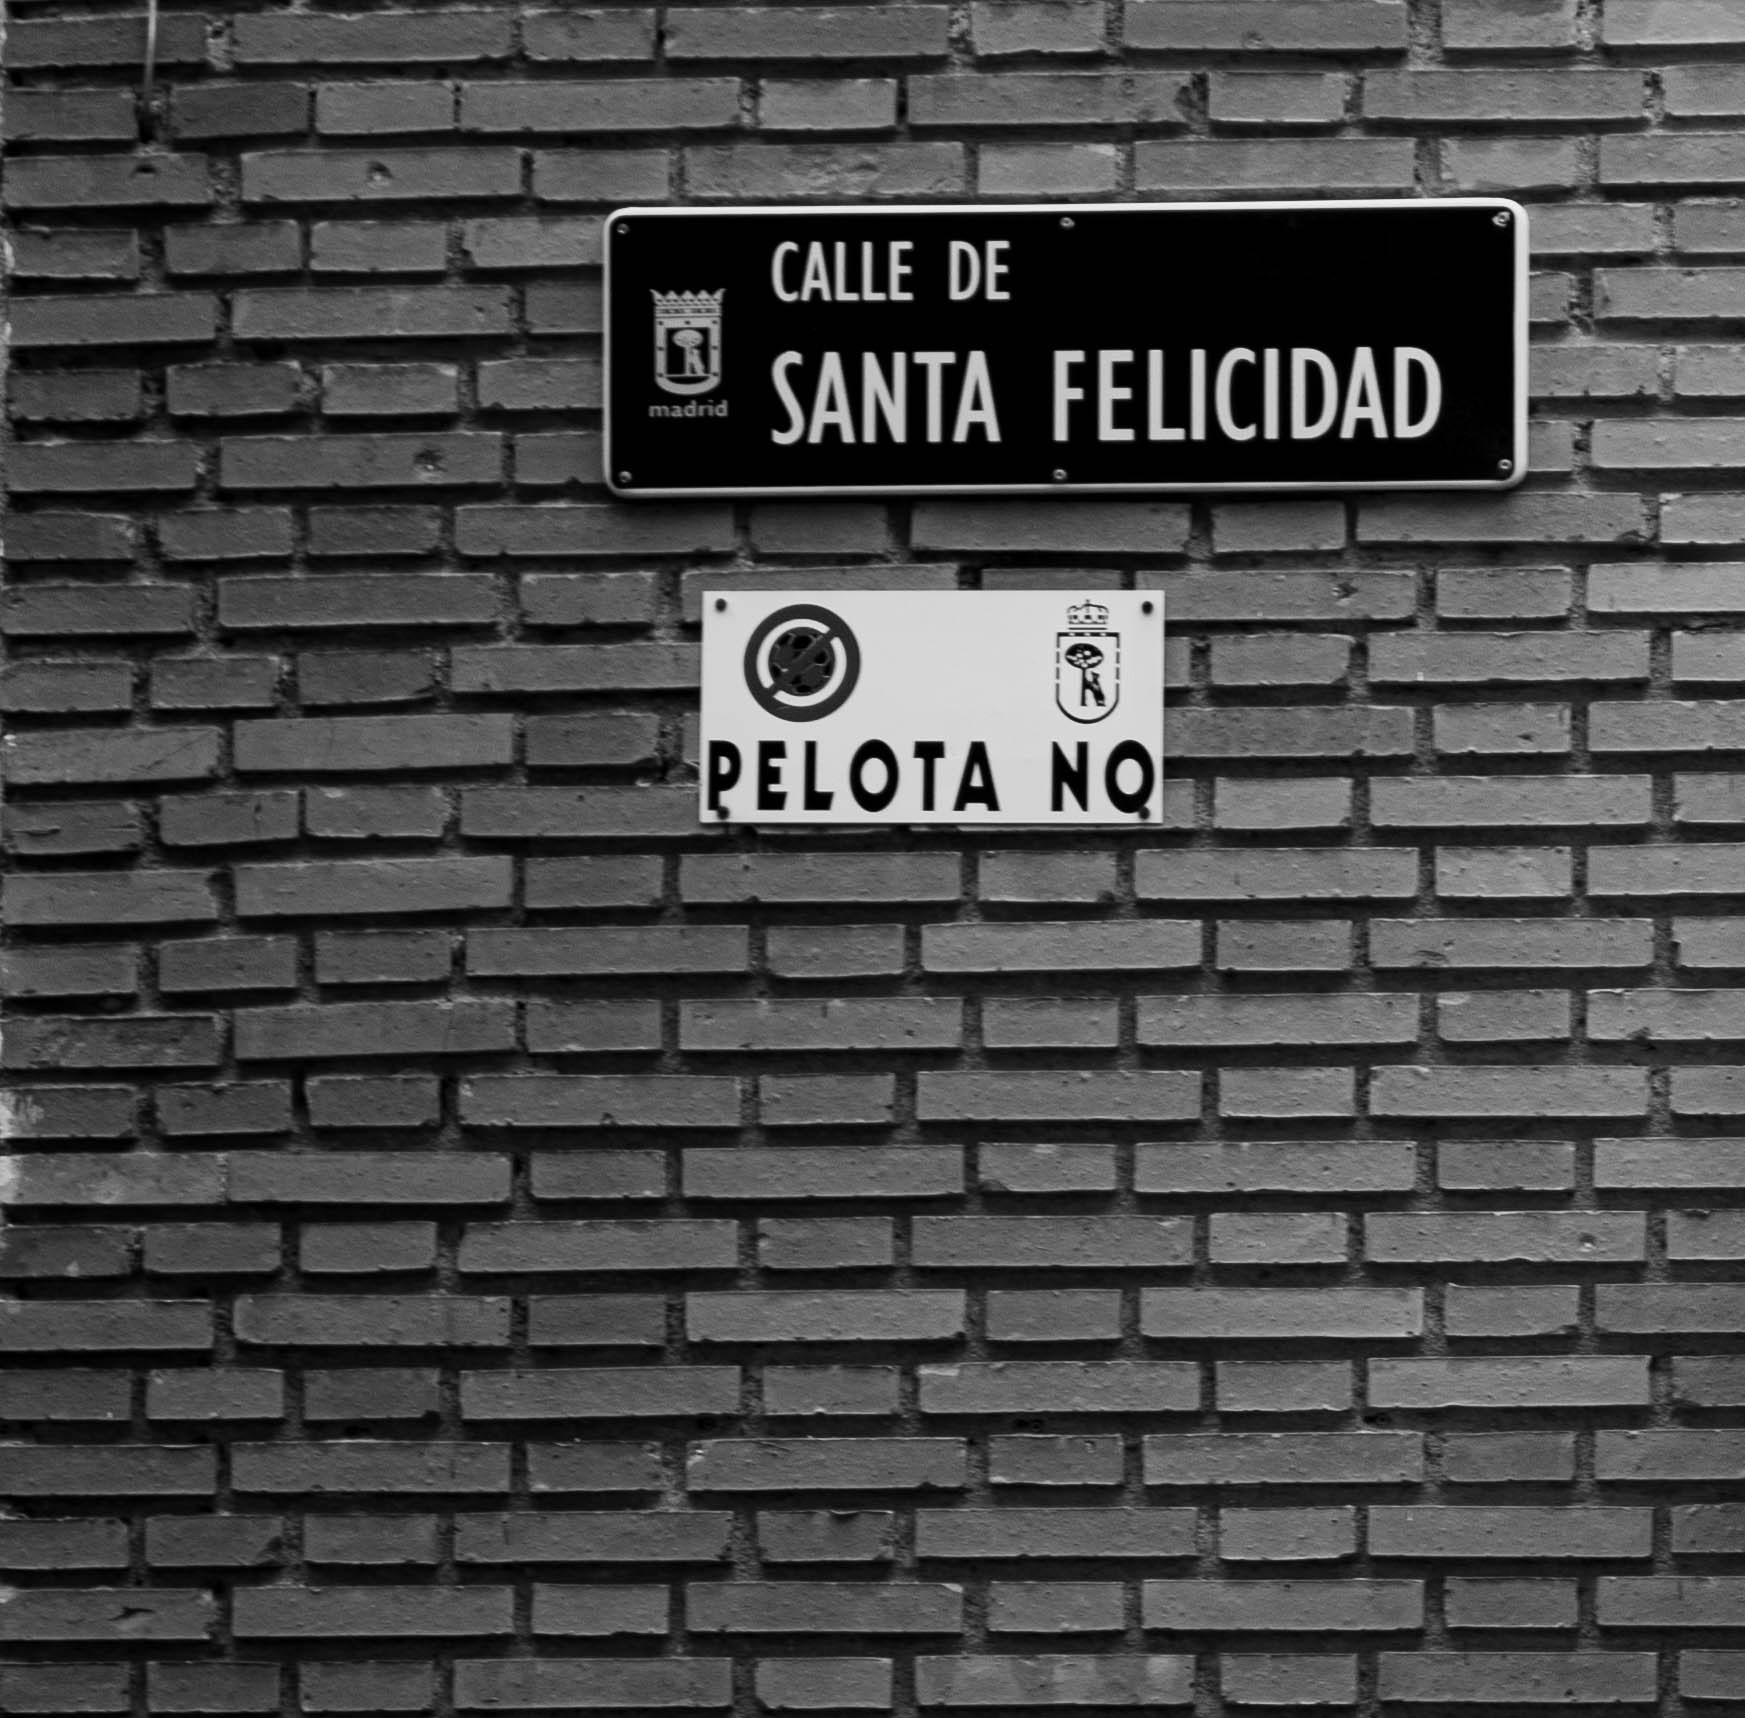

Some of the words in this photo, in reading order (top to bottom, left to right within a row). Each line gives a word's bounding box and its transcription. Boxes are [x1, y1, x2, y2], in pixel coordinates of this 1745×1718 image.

[770, 240, 914, 303] CALLE
[949, 240, 1011, 302] DE
[648, 399, 729, 419] madrid
[770, 350, 1002, 446] SANTA
[1052, 346, 1443, 442] FELICIDAD
[707, 739, 1002, 814] PELOTA
[1050, 738, 1155, 814] NO
